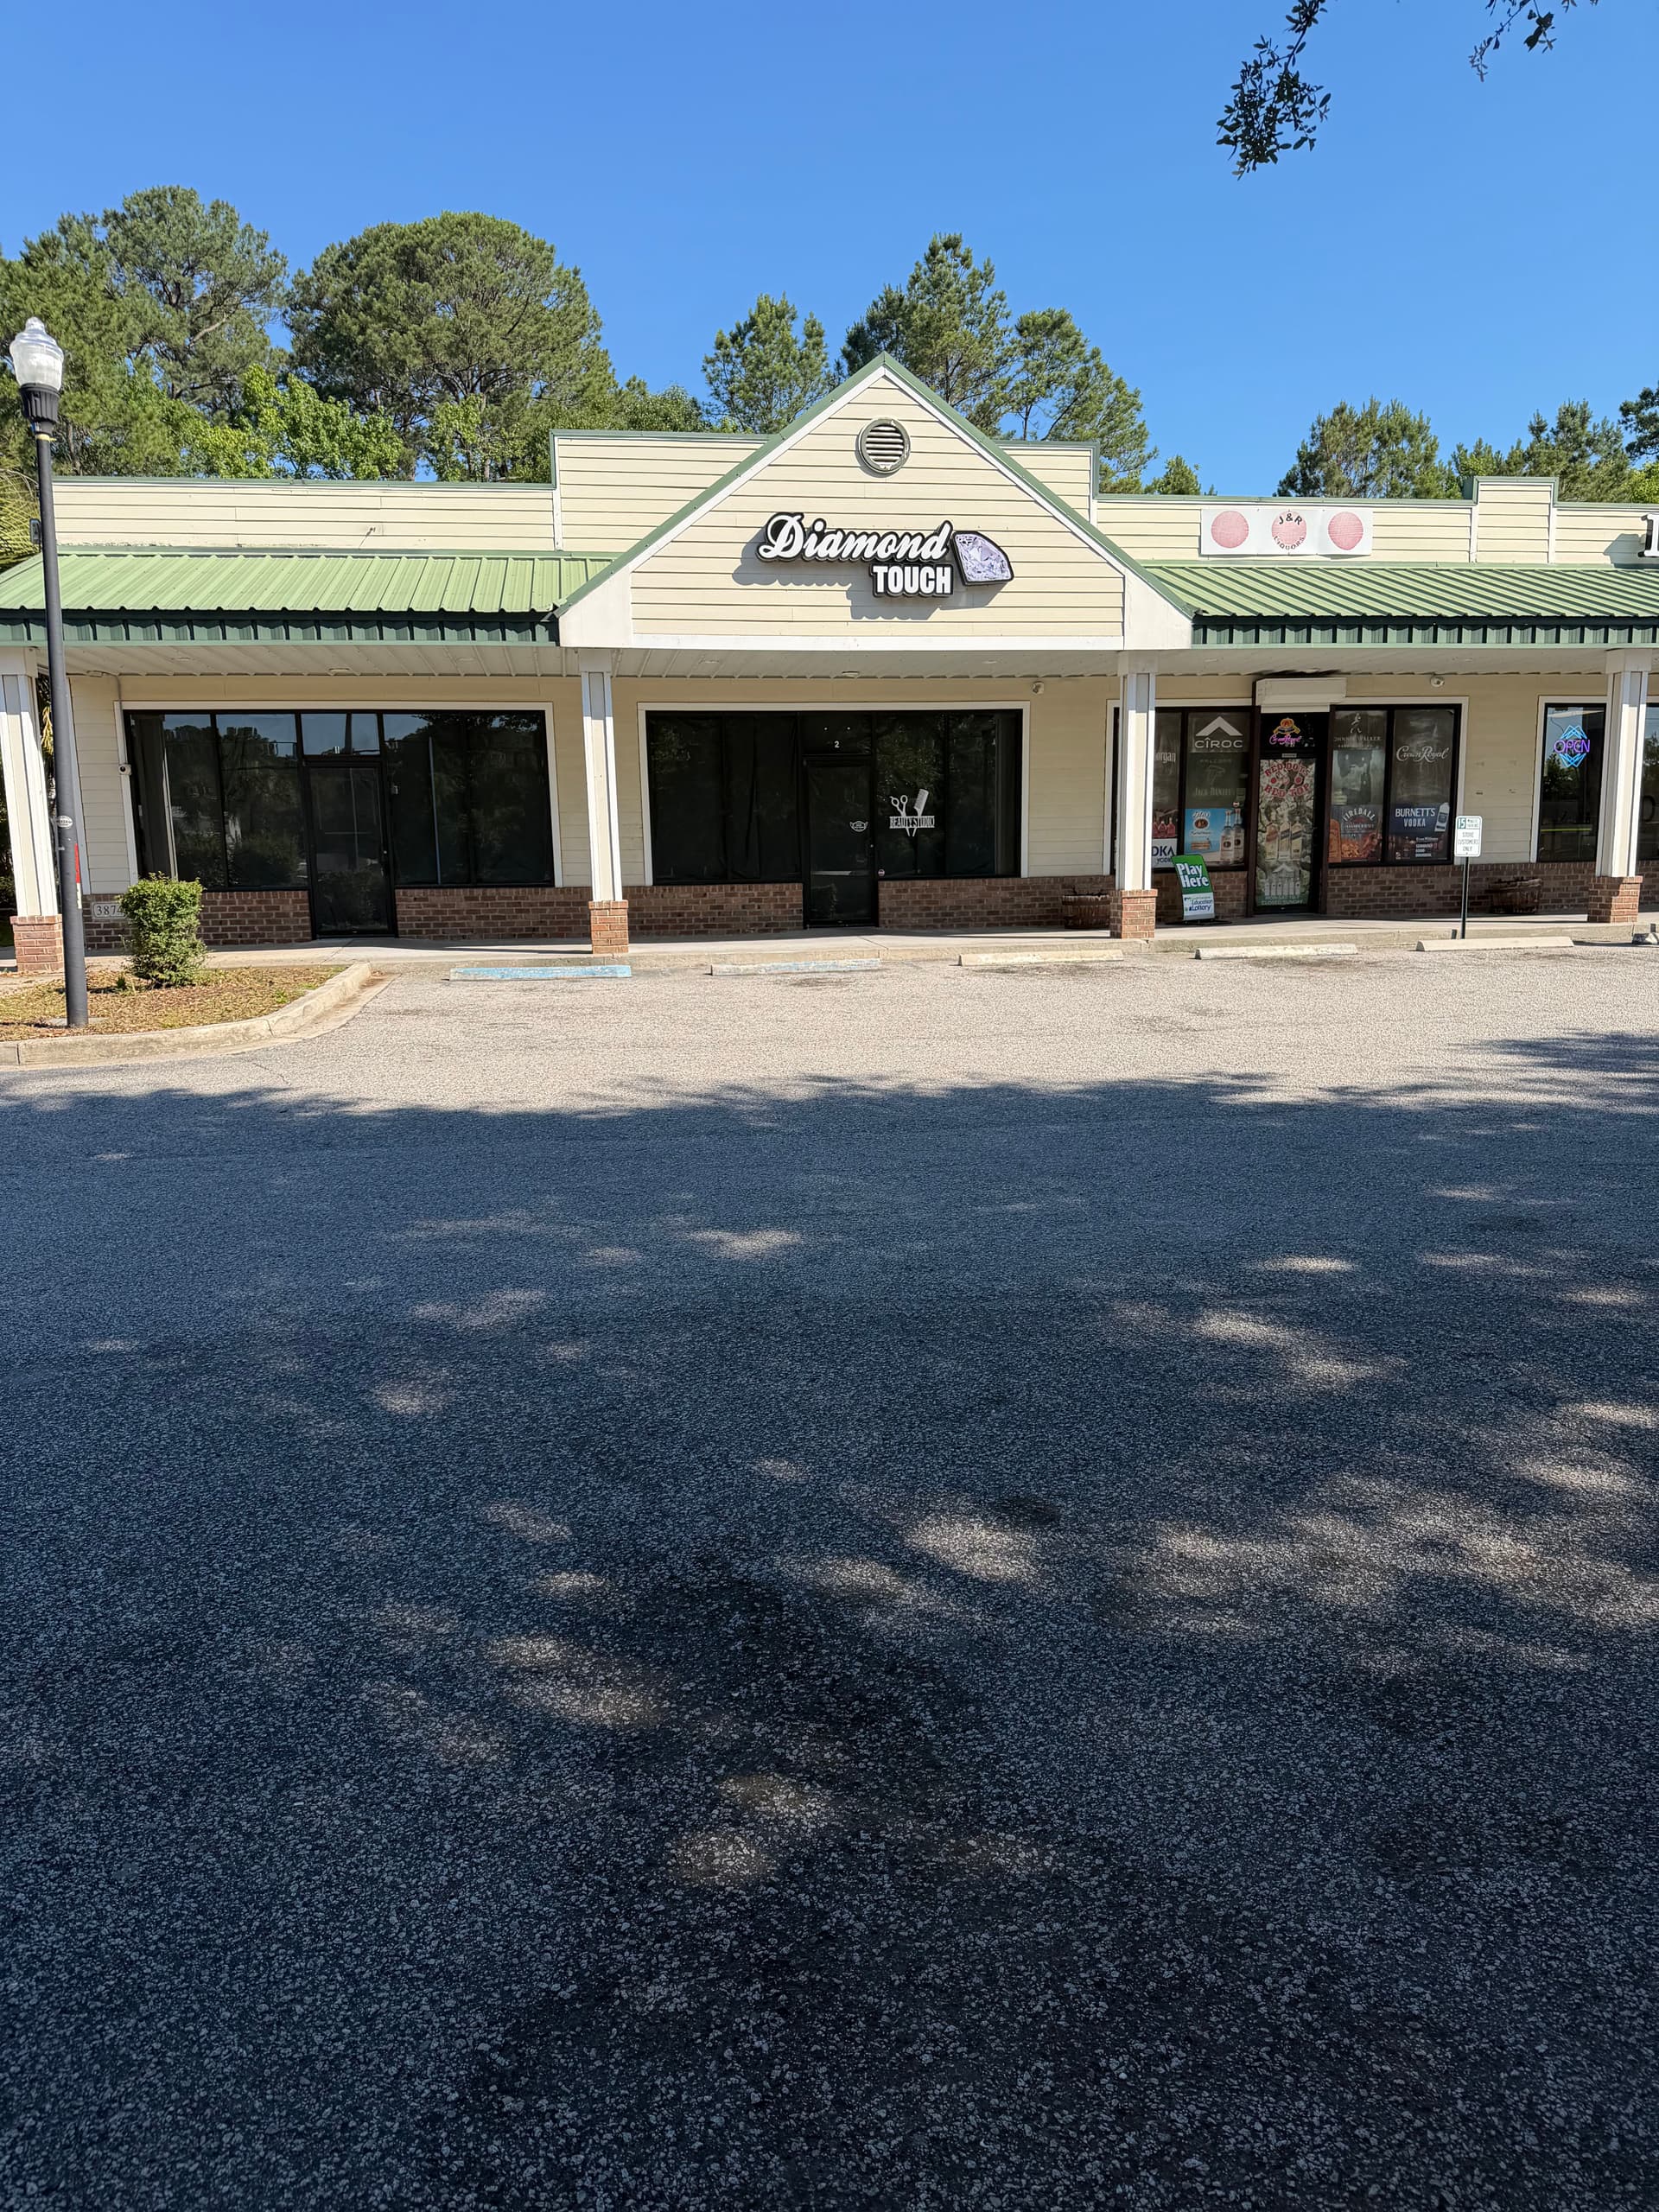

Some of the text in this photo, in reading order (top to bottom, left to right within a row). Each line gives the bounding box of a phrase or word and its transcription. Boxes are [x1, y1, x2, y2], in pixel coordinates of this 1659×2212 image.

[758, 514, 953, 561] Diamond
[1274, 536, 1305, 550] LIQUORS
[872, 565, 952, 594] TOUCH
[1554, 739, 1591, 753] OPEN
[1155, 752, 1176, 764] organ
[1396, 746, 1450, 762] Crown Royal
[1264, 764, 1283, 777] RED
[1264, 783, 1311, 798] RED TOP
[1342, 808, 1376, 822] FIREBALL
[1403, 818, 1427, 827] VODKA
[1458, 818, 1465, 829] 15
[1151, 845, 1176, 856] DKA
[1176, 863, 1203, 878] Play
[1179, 874, 1210, 888] Here
